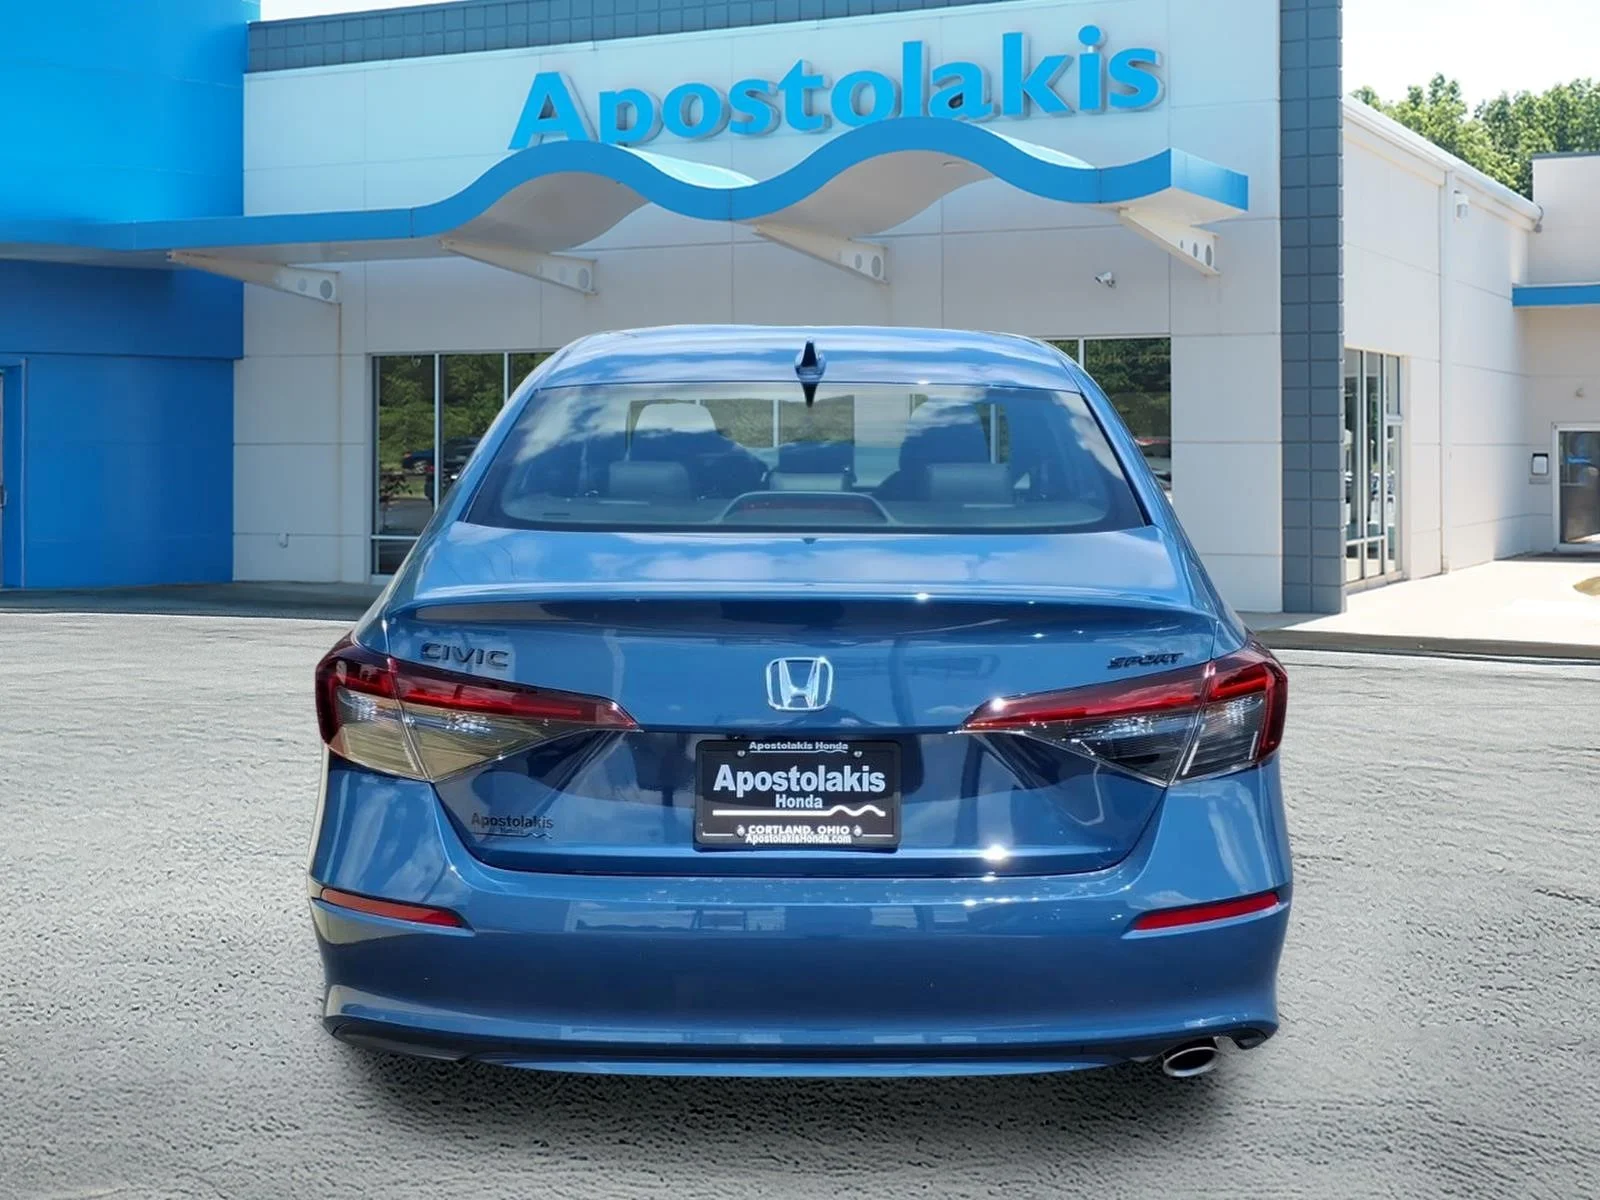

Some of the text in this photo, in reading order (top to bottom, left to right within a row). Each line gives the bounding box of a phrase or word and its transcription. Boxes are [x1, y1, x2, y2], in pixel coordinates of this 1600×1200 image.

[509, 24, 1164, 149] Apostolakis
[421, 642, 510, 671] CIVIC
[1107, 652, 1185, 670] SPORT
[749, 741, 849, 752] Apostolakis Honda
[713, 764, 887, 798] Apostolakis
[775, 794, 824, 809] Honda
[472, 812, 555, 829] Apostolakis
[817, 825, 850, 835] OHIO
[745, 833, 852, 845] ApostolakisHonda.com
